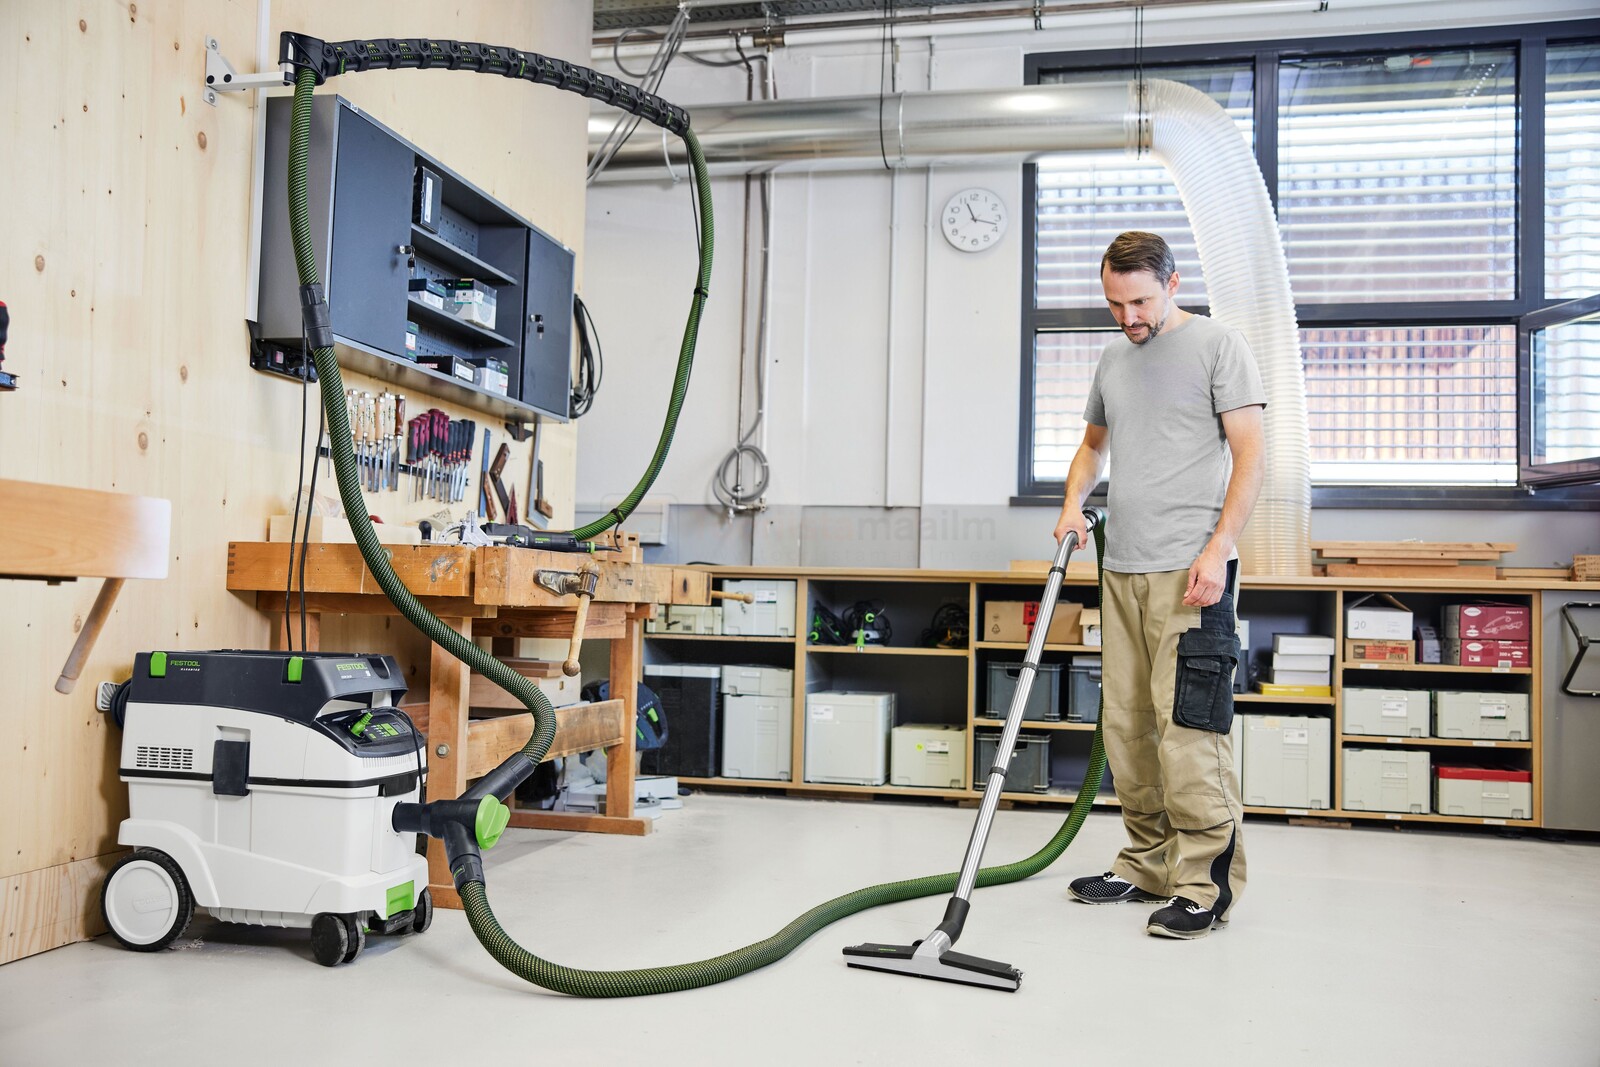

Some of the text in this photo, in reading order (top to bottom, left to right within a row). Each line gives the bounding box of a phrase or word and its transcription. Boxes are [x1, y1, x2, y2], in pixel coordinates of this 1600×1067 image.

[960, 197, 967, 205] 11
[970, 193, 979, 201] 12
[950, 206, 960, 214] 10
[991, 203, 998, 211] 2
[948, 217, 956, 225] 9
[994, 214, 1001, 222] 3
[951, 228, 959, 236] 8
[991, 225, 998, 233] 4
[960, 235, 967, 243] 7
[971, 238, 979, 246] 6
[983, 234, 990, 242] 5
[170, 659, 201, 667] FESTOOL
[335, 662, 368, 671] FESTOOL
